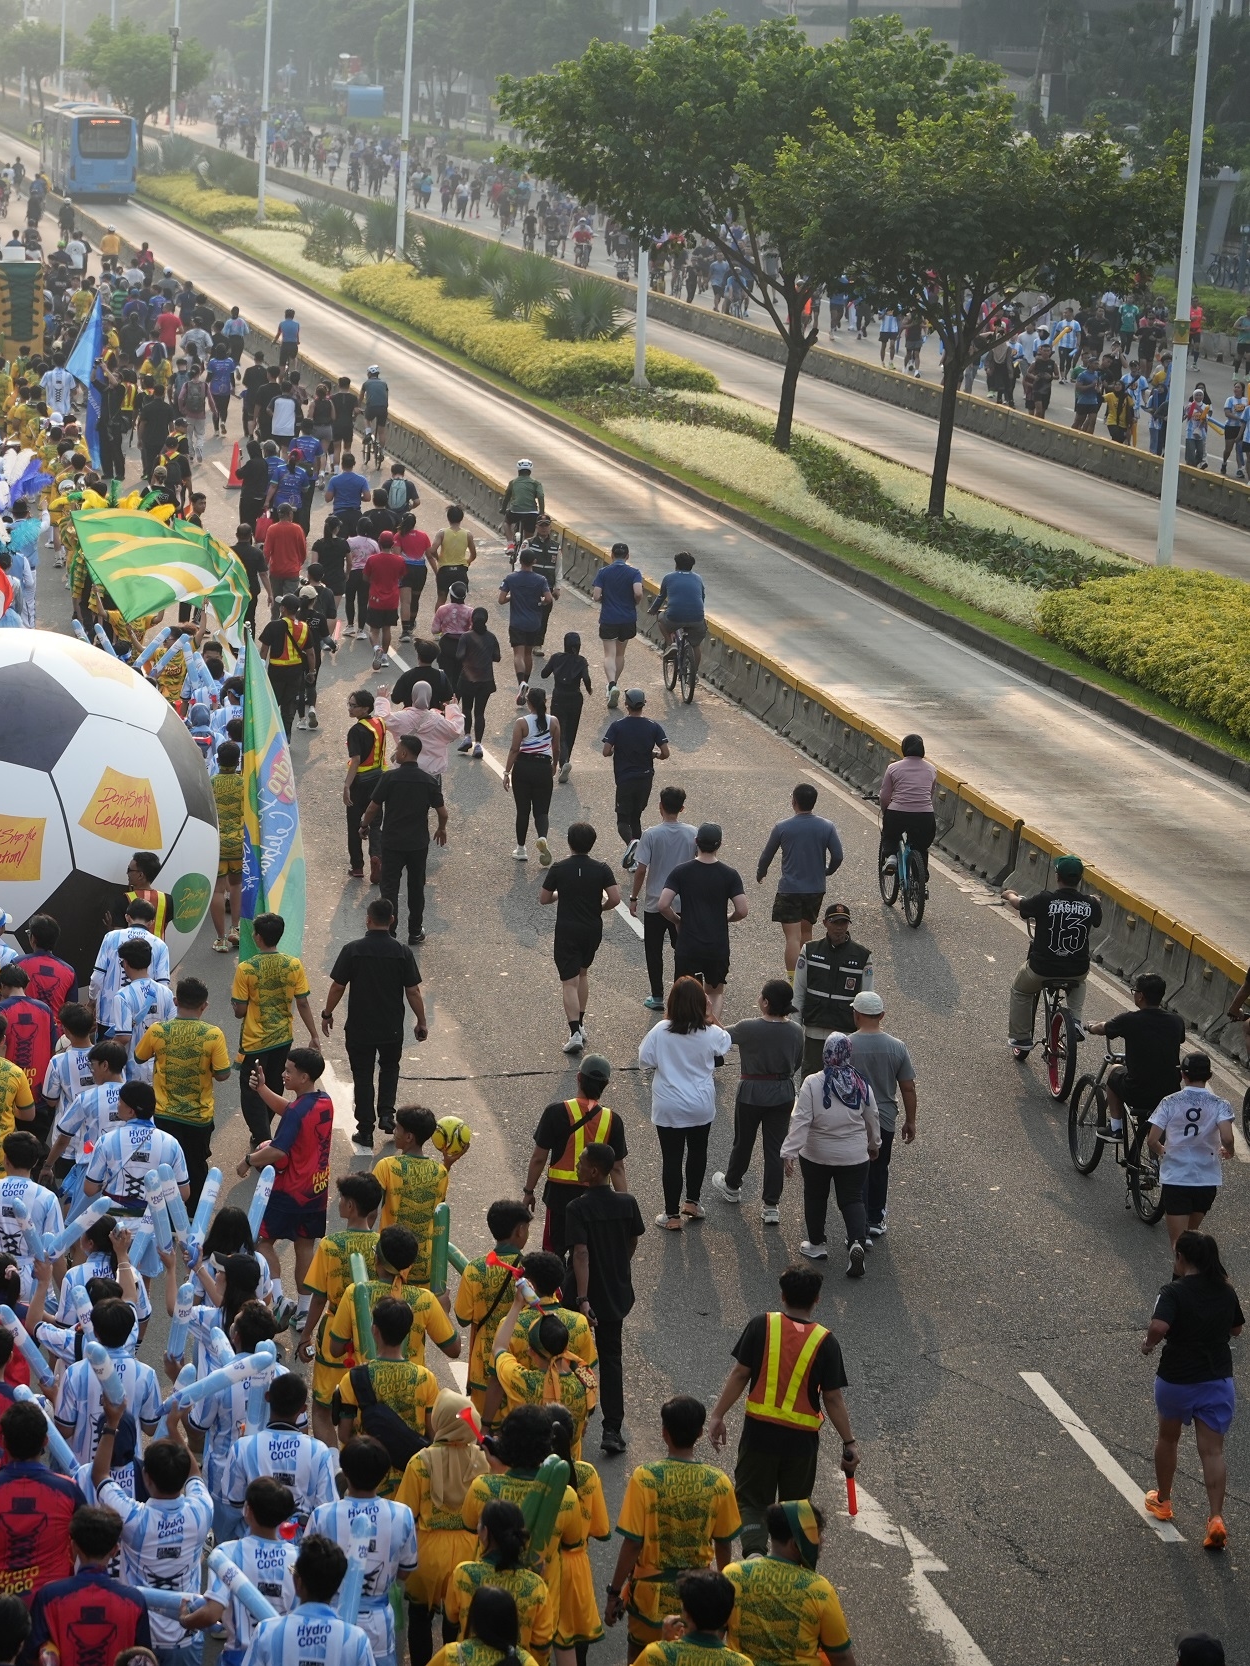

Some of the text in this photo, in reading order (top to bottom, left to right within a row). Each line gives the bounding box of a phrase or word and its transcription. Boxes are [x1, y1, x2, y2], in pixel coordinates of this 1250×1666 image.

[0, 829, 24, 845] Stop
[24, 826, 37, 842] the
[1048, 912, 1088, 955] 13
[129, 1129, 153, 1139] Hydro
[1, 1182, 29, 1192] Hydro
[376, 1370, 411, 1384] Hydro
[269, 1439, 300, 1451] Hydro
[665, 1469, 706, 1486] Hydro
[157, 1516, 185, 1531] Hydro
[255, 1548, 287, 1560] Hydro
[752, 1567, 799, 1584] Hydro
[297, 1623, 332, 1637] Hydro
